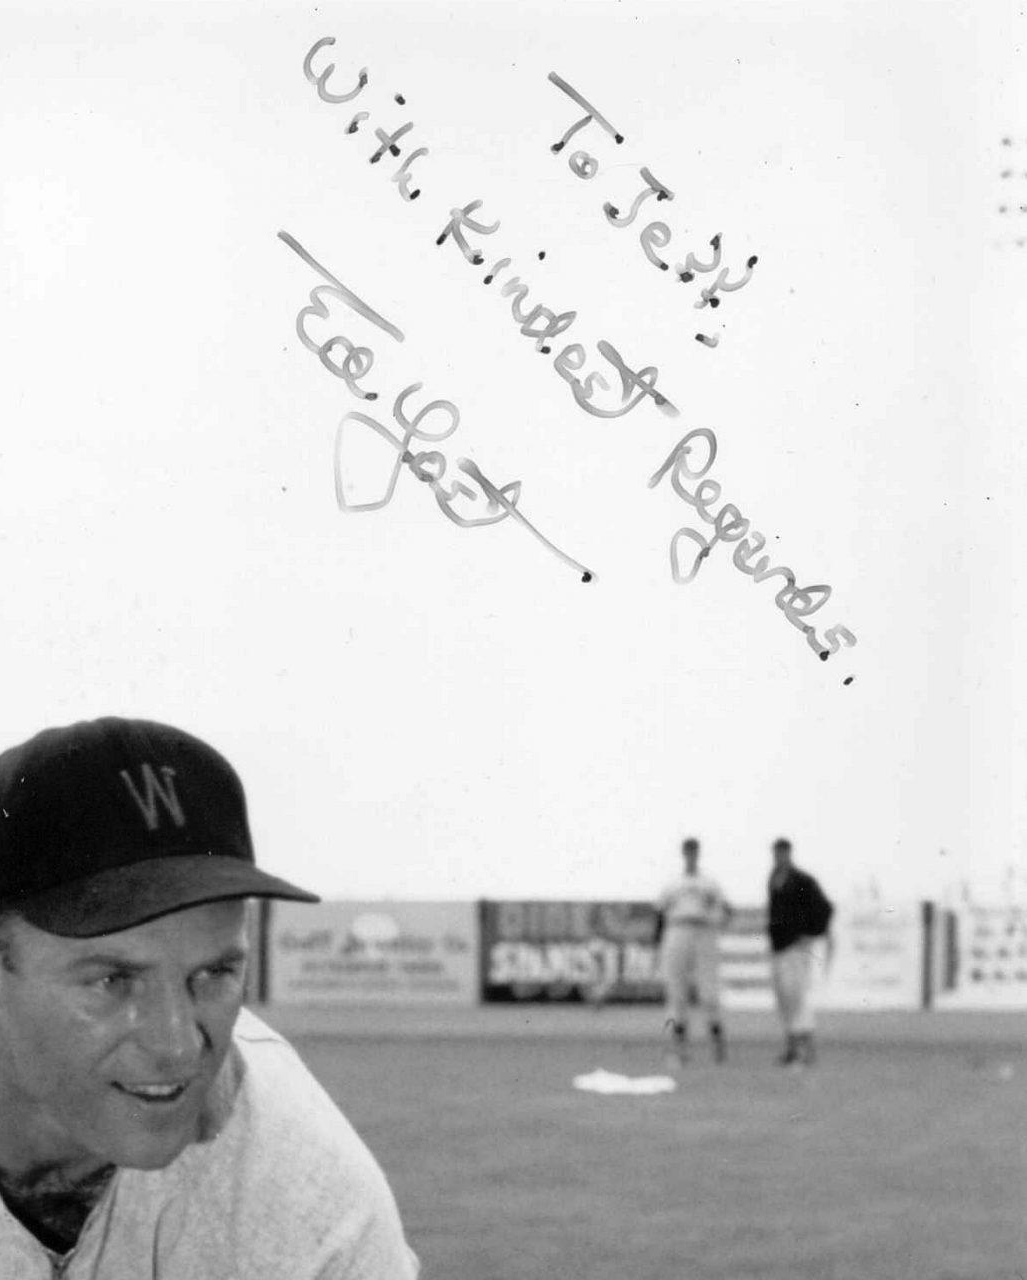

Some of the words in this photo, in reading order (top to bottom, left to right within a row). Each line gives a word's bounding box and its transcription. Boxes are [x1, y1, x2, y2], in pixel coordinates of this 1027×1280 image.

[547, 71, 625, 180] To
[303, 37, 429, 202] With
[435, 200, 680, 419] Kindest
[120, 762, 185, 830] W
